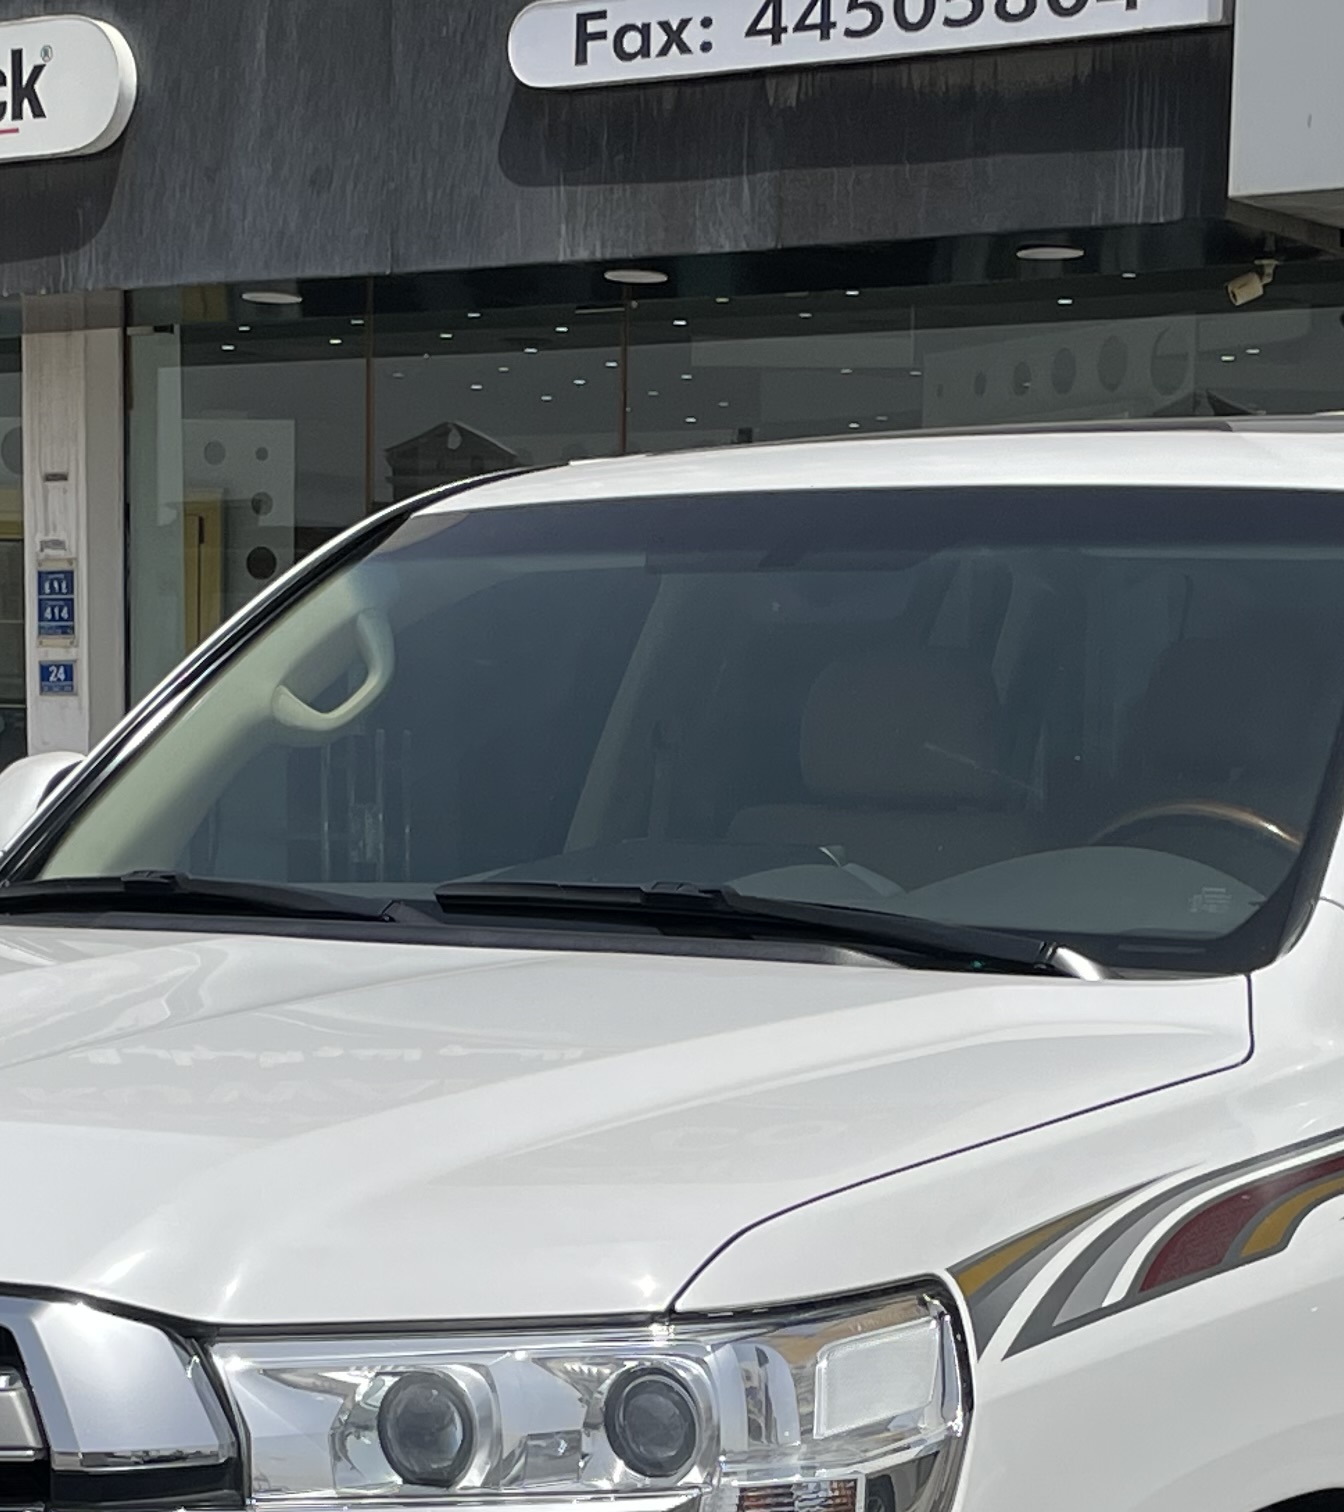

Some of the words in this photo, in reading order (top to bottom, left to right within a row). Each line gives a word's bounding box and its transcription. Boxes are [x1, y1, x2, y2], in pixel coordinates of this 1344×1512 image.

[574, 9, 713, 66] Fax:
[43, 605, 70, 621] 414
[48, 664, 66, 682] 24
